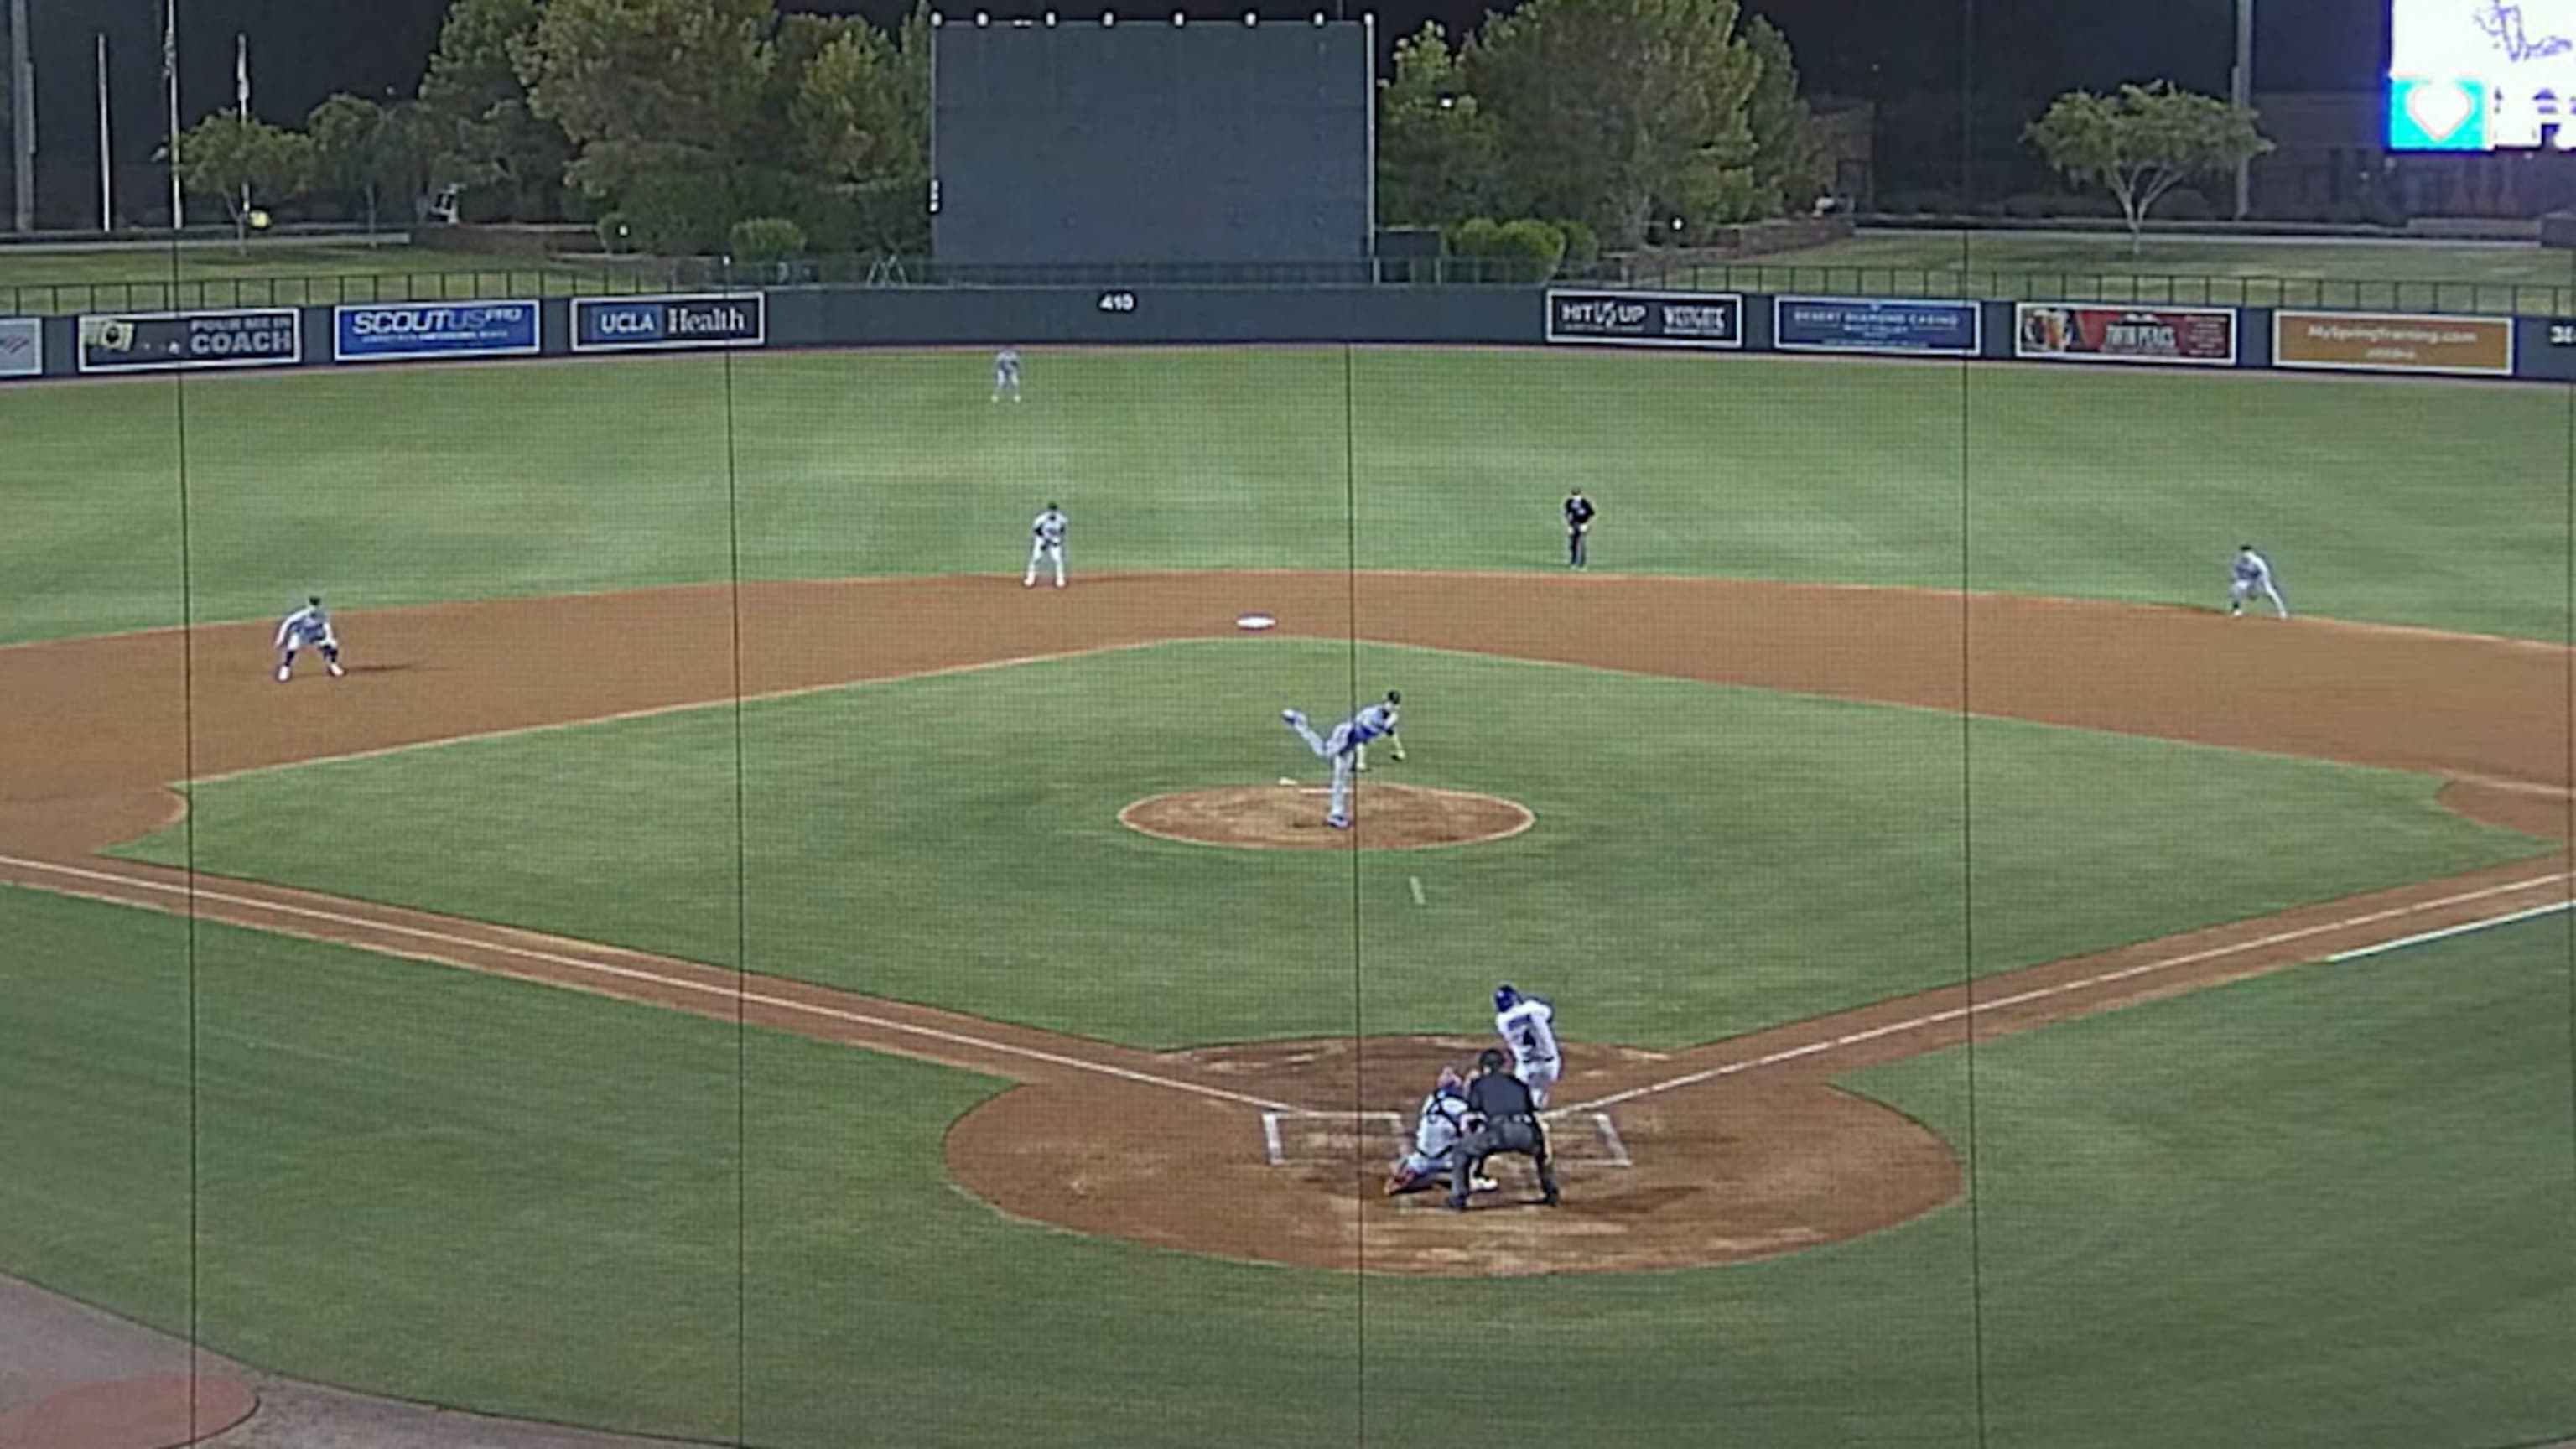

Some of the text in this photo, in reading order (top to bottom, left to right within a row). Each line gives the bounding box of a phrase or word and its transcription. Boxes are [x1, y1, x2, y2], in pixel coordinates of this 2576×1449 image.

[1099, 293, 1135, 311] 410
[600, 307, 745, 333] UCLA Health
[190, 330, 292, 354] COACH
